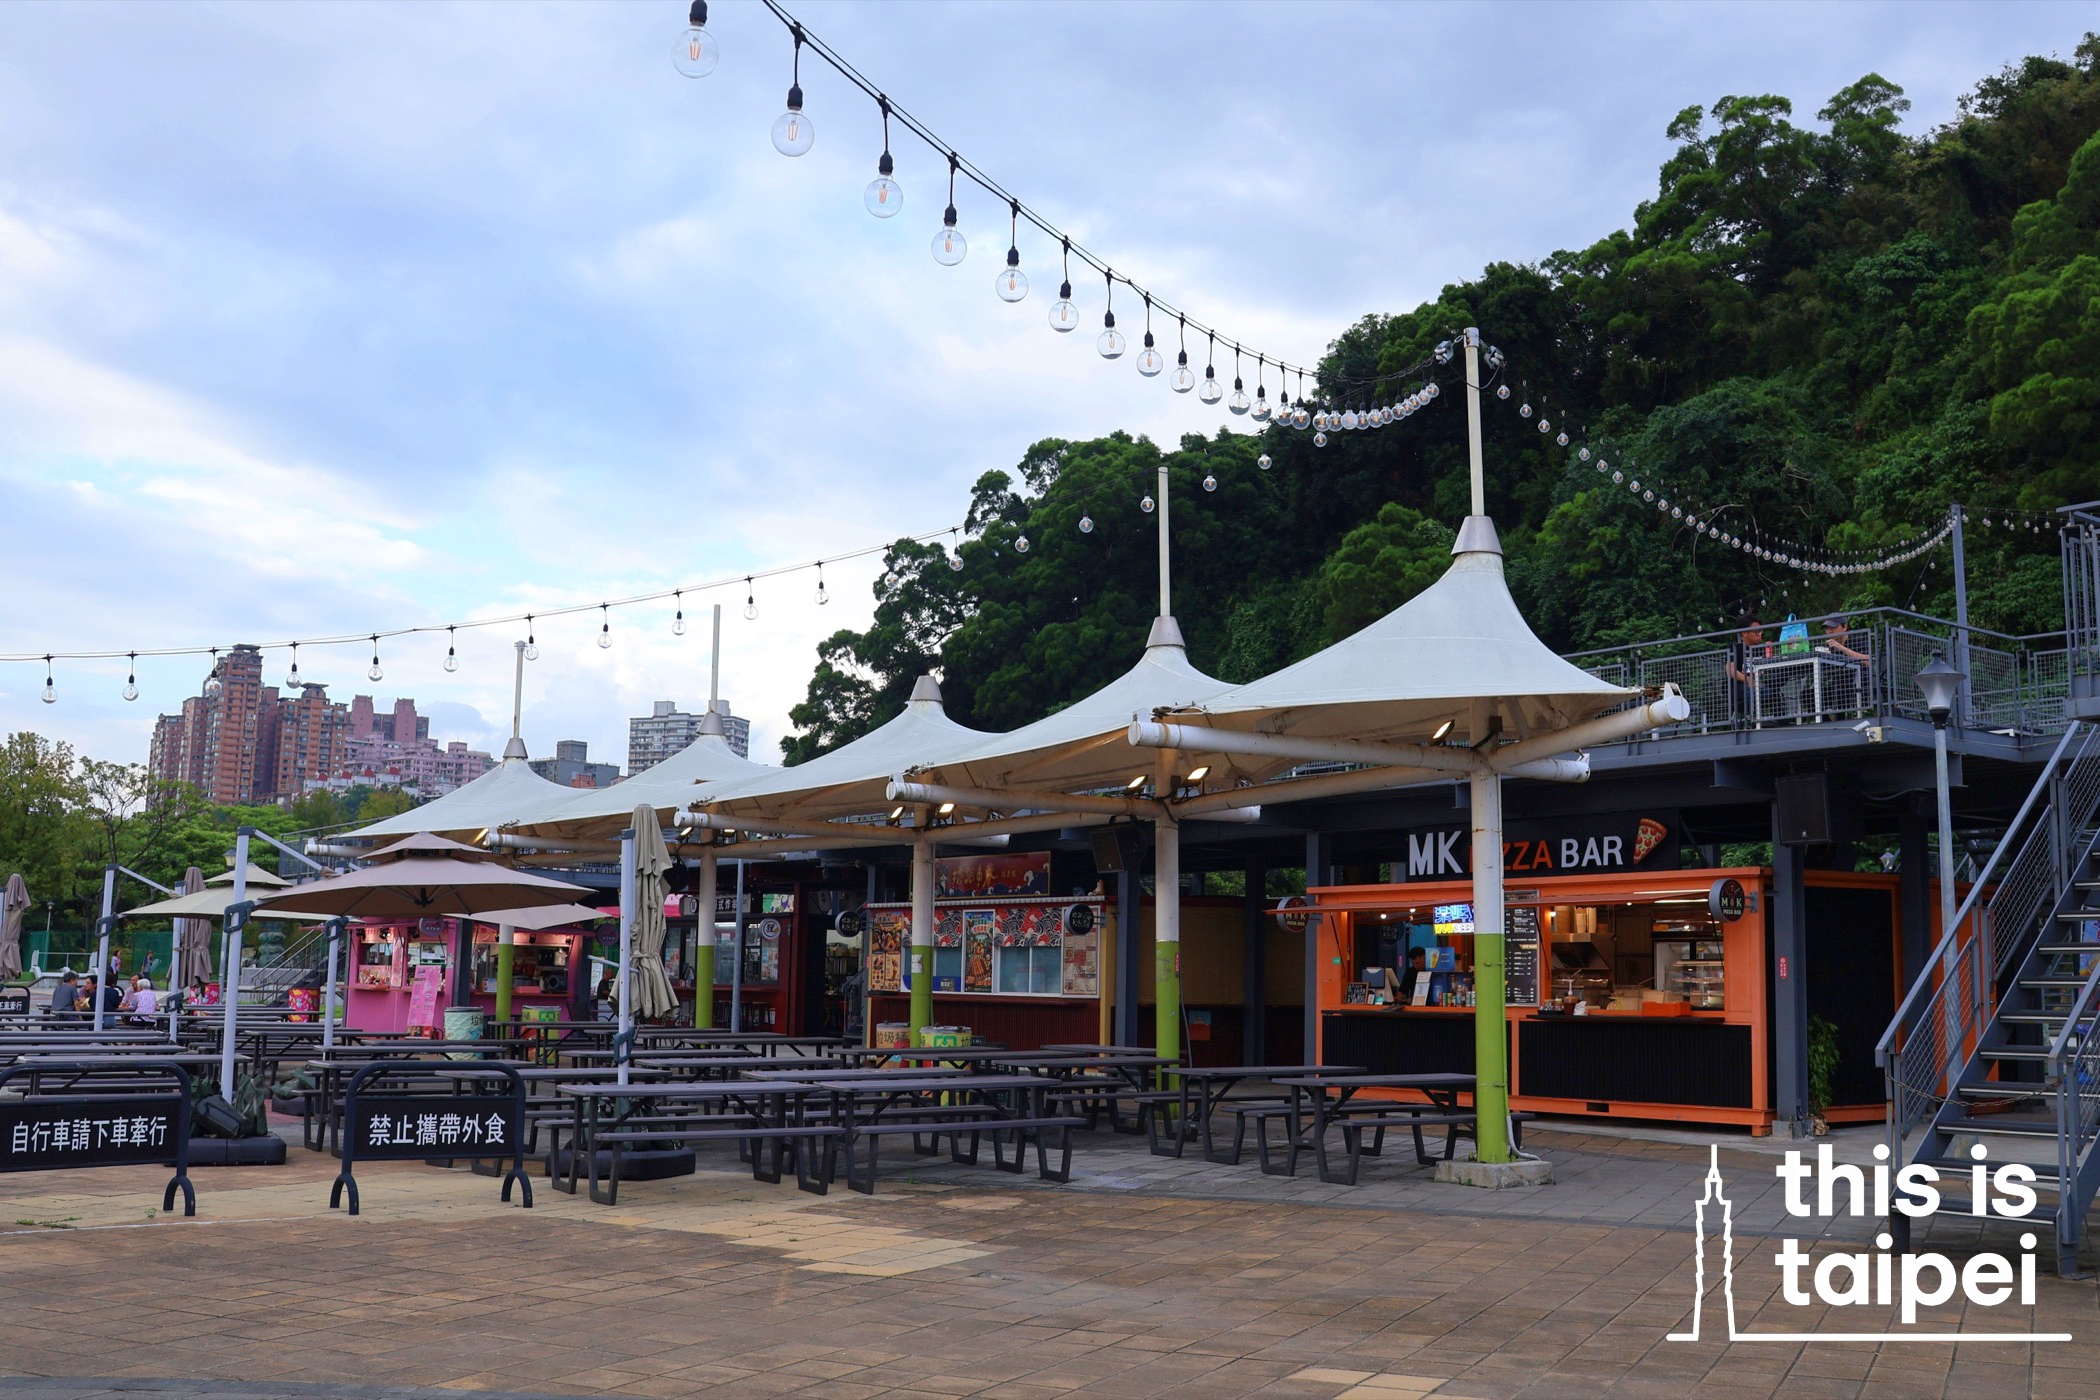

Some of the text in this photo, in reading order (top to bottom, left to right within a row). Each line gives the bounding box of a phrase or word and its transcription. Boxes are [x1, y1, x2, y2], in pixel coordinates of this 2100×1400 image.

[1409, 830, 1463, 876] MK
[1561, 835, 1623, 868] BAR
[12, 1115, 167, 1153] 自行車請下車牽行
[369, 1112, 506, 1146] 禁止攜帶外食
